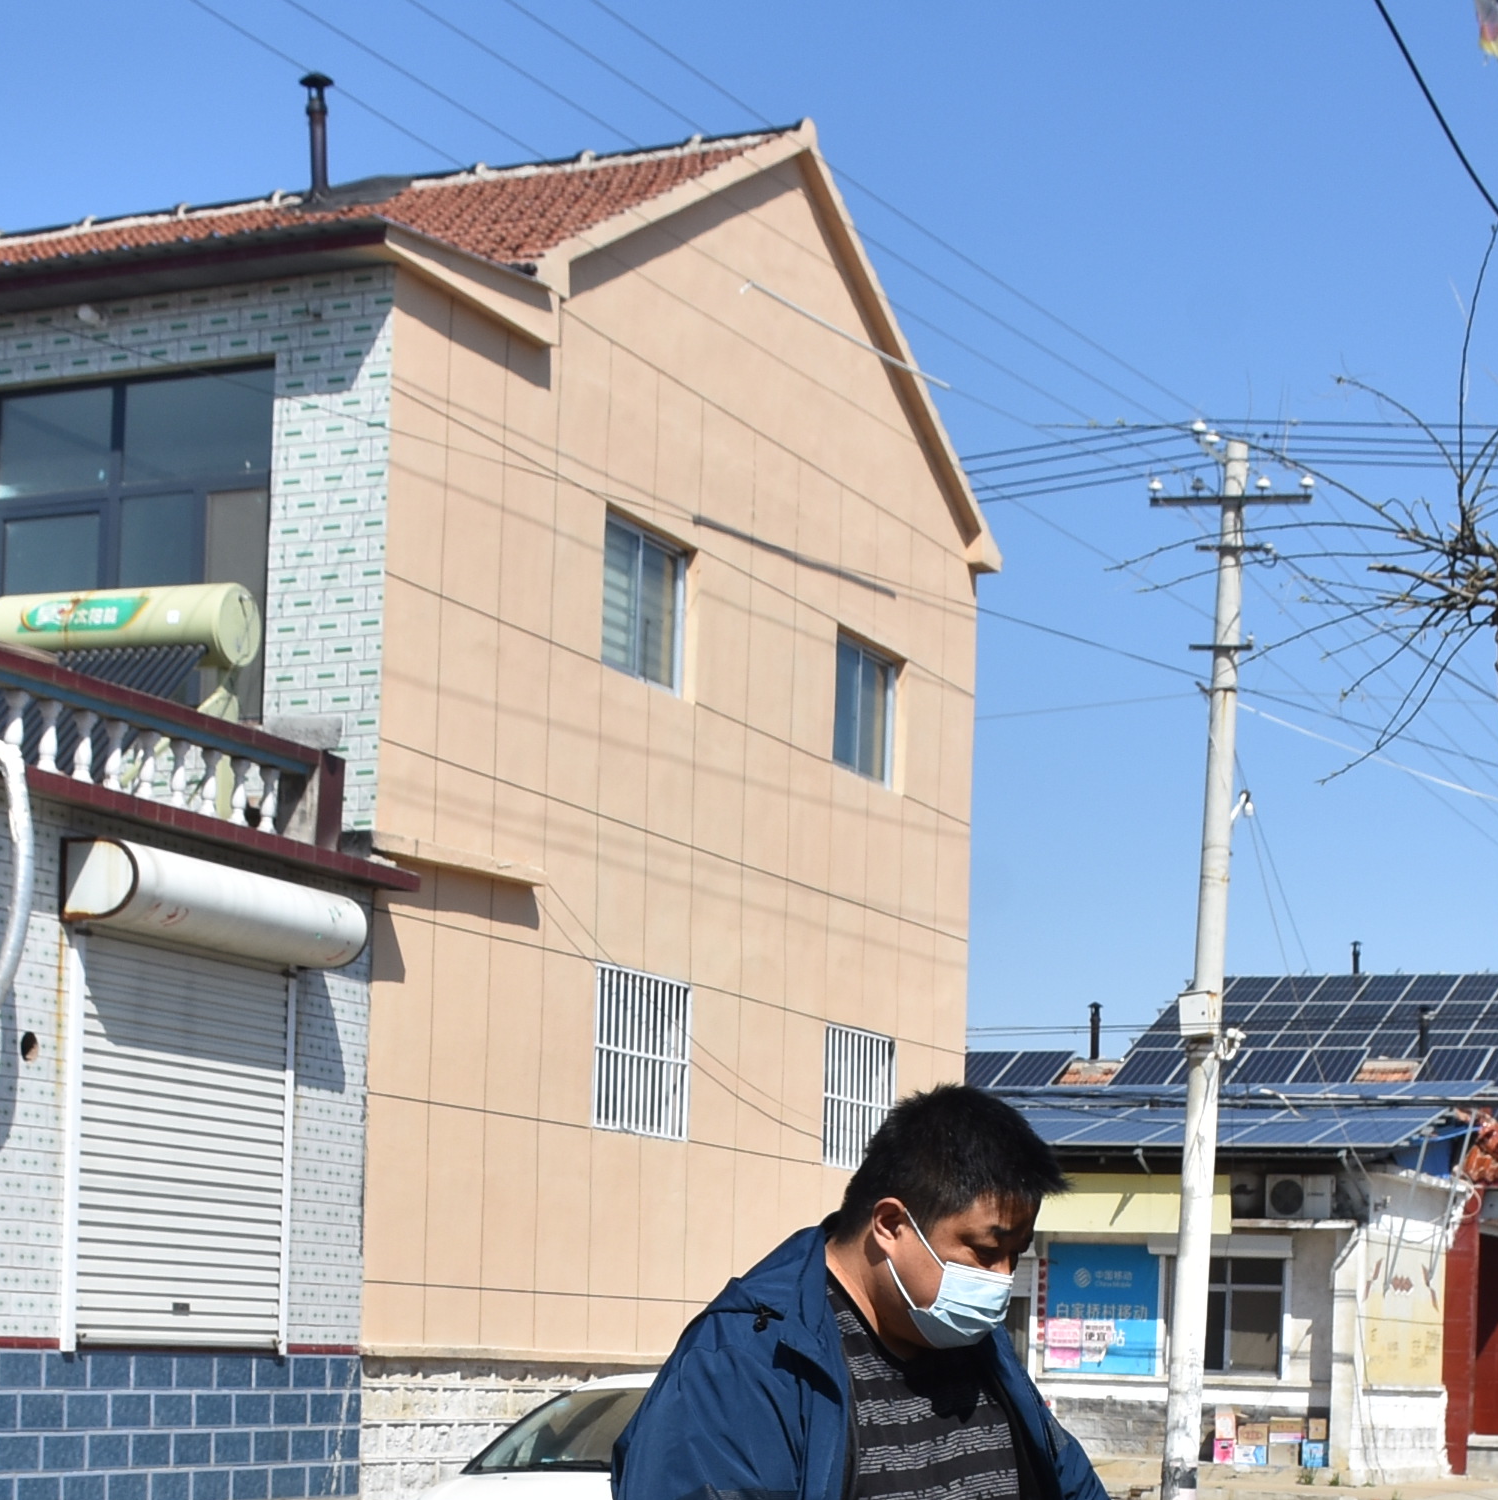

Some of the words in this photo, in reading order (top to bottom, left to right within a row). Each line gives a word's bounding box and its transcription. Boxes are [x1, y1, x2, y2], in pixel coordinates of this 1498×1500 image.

[1095, 1270, 1133, 1281] 中国移动
[1056, 1302, 1148, 1322] 白家桥村移动
